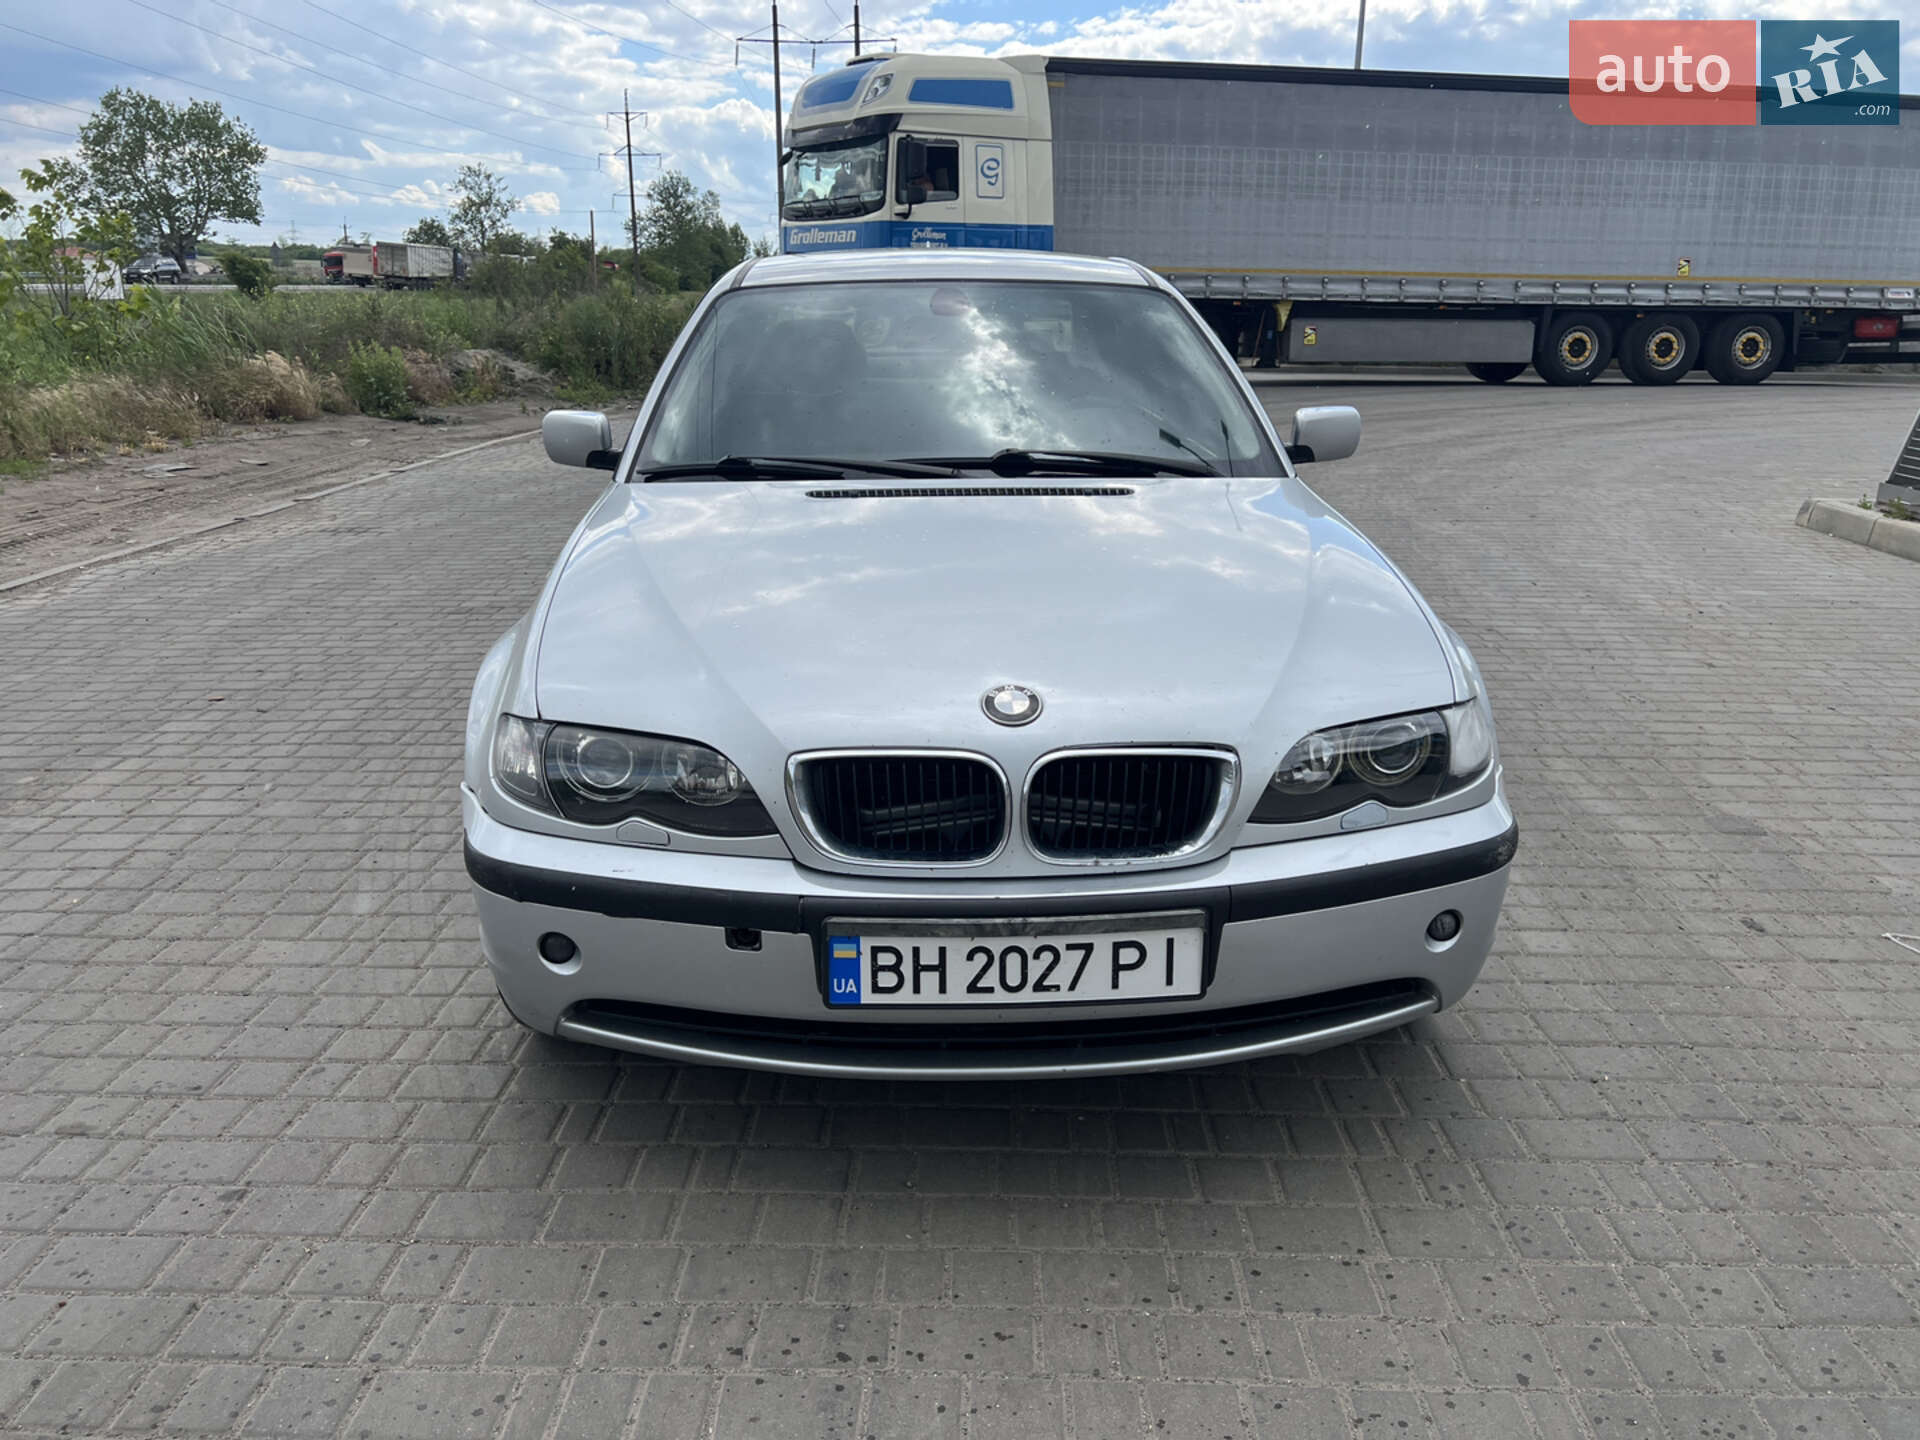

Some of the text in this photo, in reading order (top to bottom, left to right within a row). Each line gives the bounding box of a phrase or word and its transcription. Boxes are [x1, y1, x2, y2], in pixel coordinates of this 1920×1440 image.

[790, 228, 857, 244] Grolleman
[869, 945, 948, 994] BH
[965, 942, 1095, 993] 2027
[833, 978, 857, 993] UA
